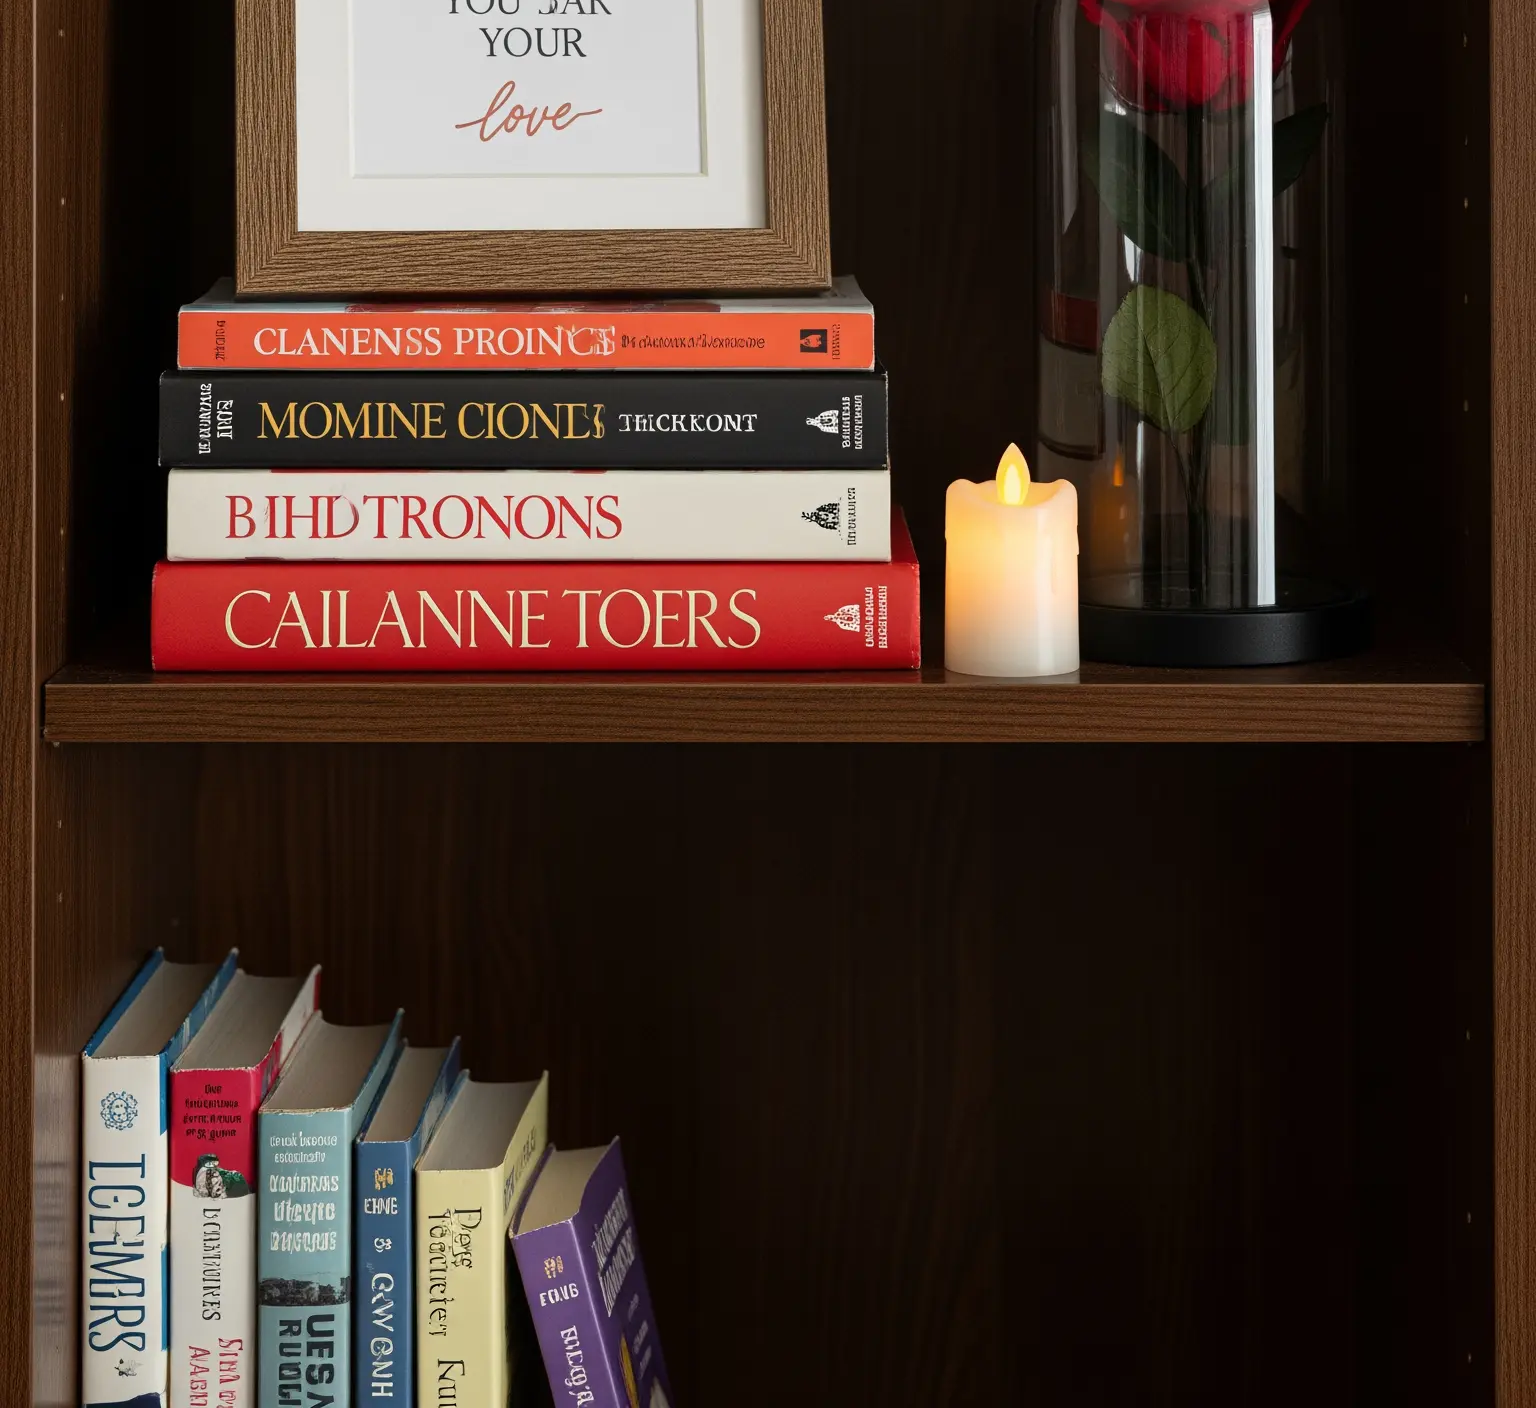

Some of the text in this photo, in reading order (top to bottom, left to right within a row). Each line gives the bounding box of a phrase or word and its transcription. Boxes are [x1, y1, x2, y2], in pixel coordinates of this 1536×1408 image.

[479, 27, 587, 58] YOUR
[455, 80, 603, 143] love
[256, 401, 447, 440] MOMINE
[224, 588, 762, 650] CAILANNE TOERS
